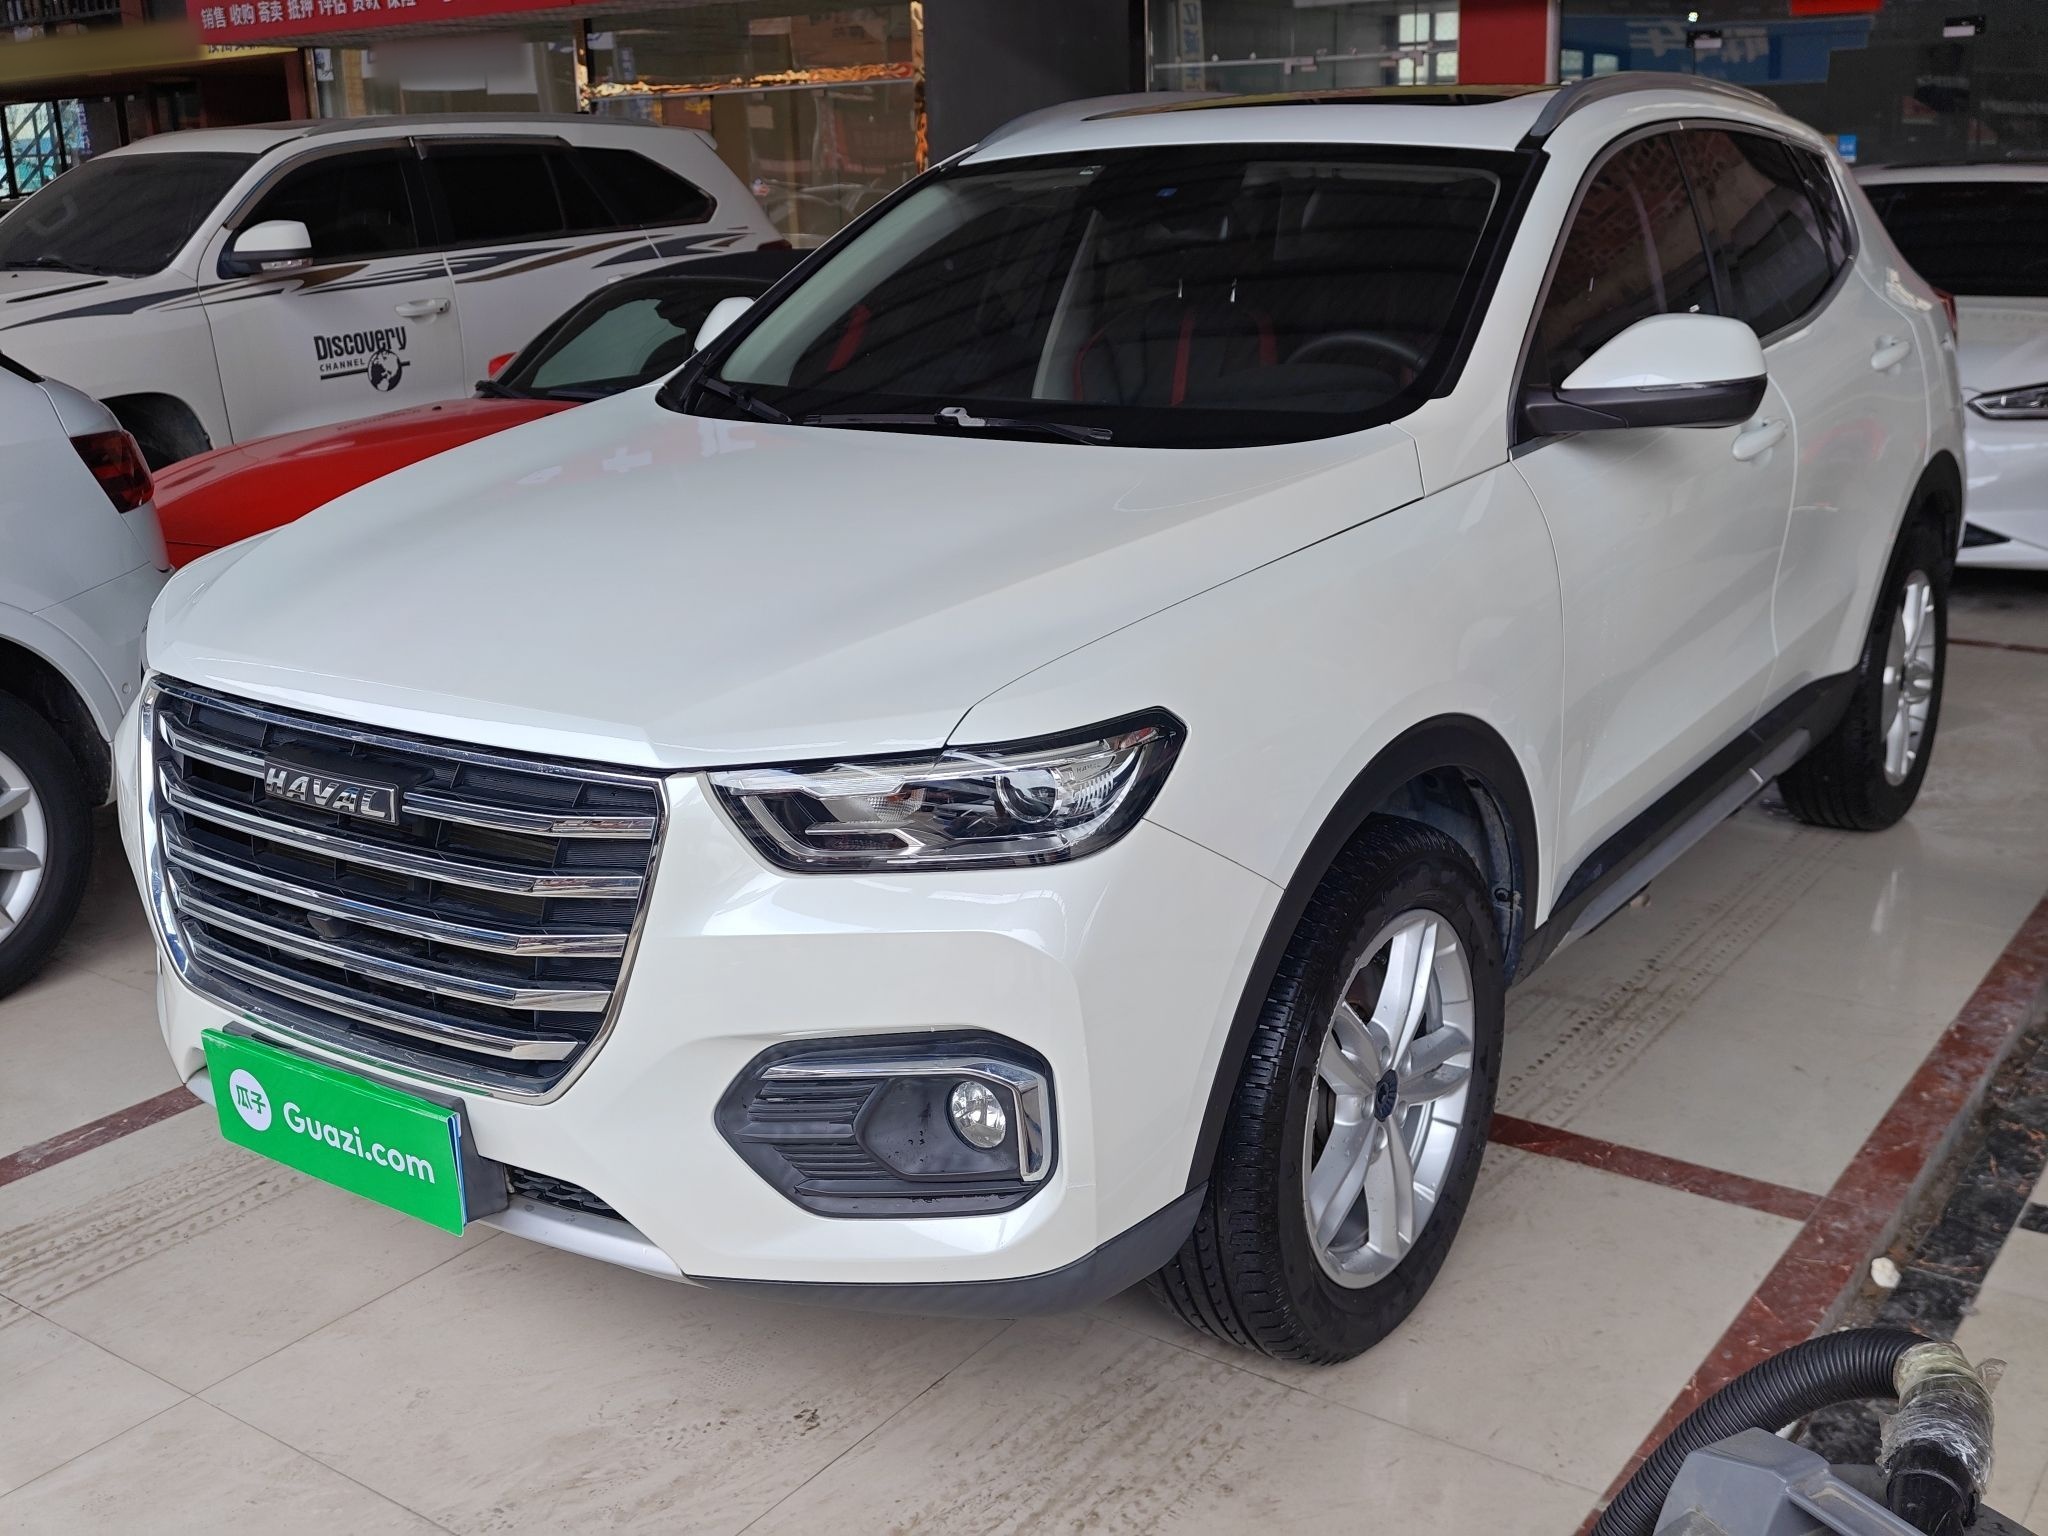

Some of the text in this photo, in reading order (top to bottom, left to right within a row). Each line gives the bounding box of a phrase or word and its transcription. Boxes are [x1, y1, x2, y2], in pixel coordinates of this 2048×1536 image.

[201, 7, 227, 29] 销售
[229, 3, 256, 26] 收购
[257, 1, 284, 23] 寄卖
[287, 0, 313, 20] 抵押
[318, 0, 347, 16] 评估
[314, 326, 407, 361] Discovery
[319, 358, 366, 373] CHANNEL
[266, 767, 386, 818] HAVAL
[235, 1084, 267, 1115] 瓜子
[283, 1101, 436, 1184] Guazi.com
